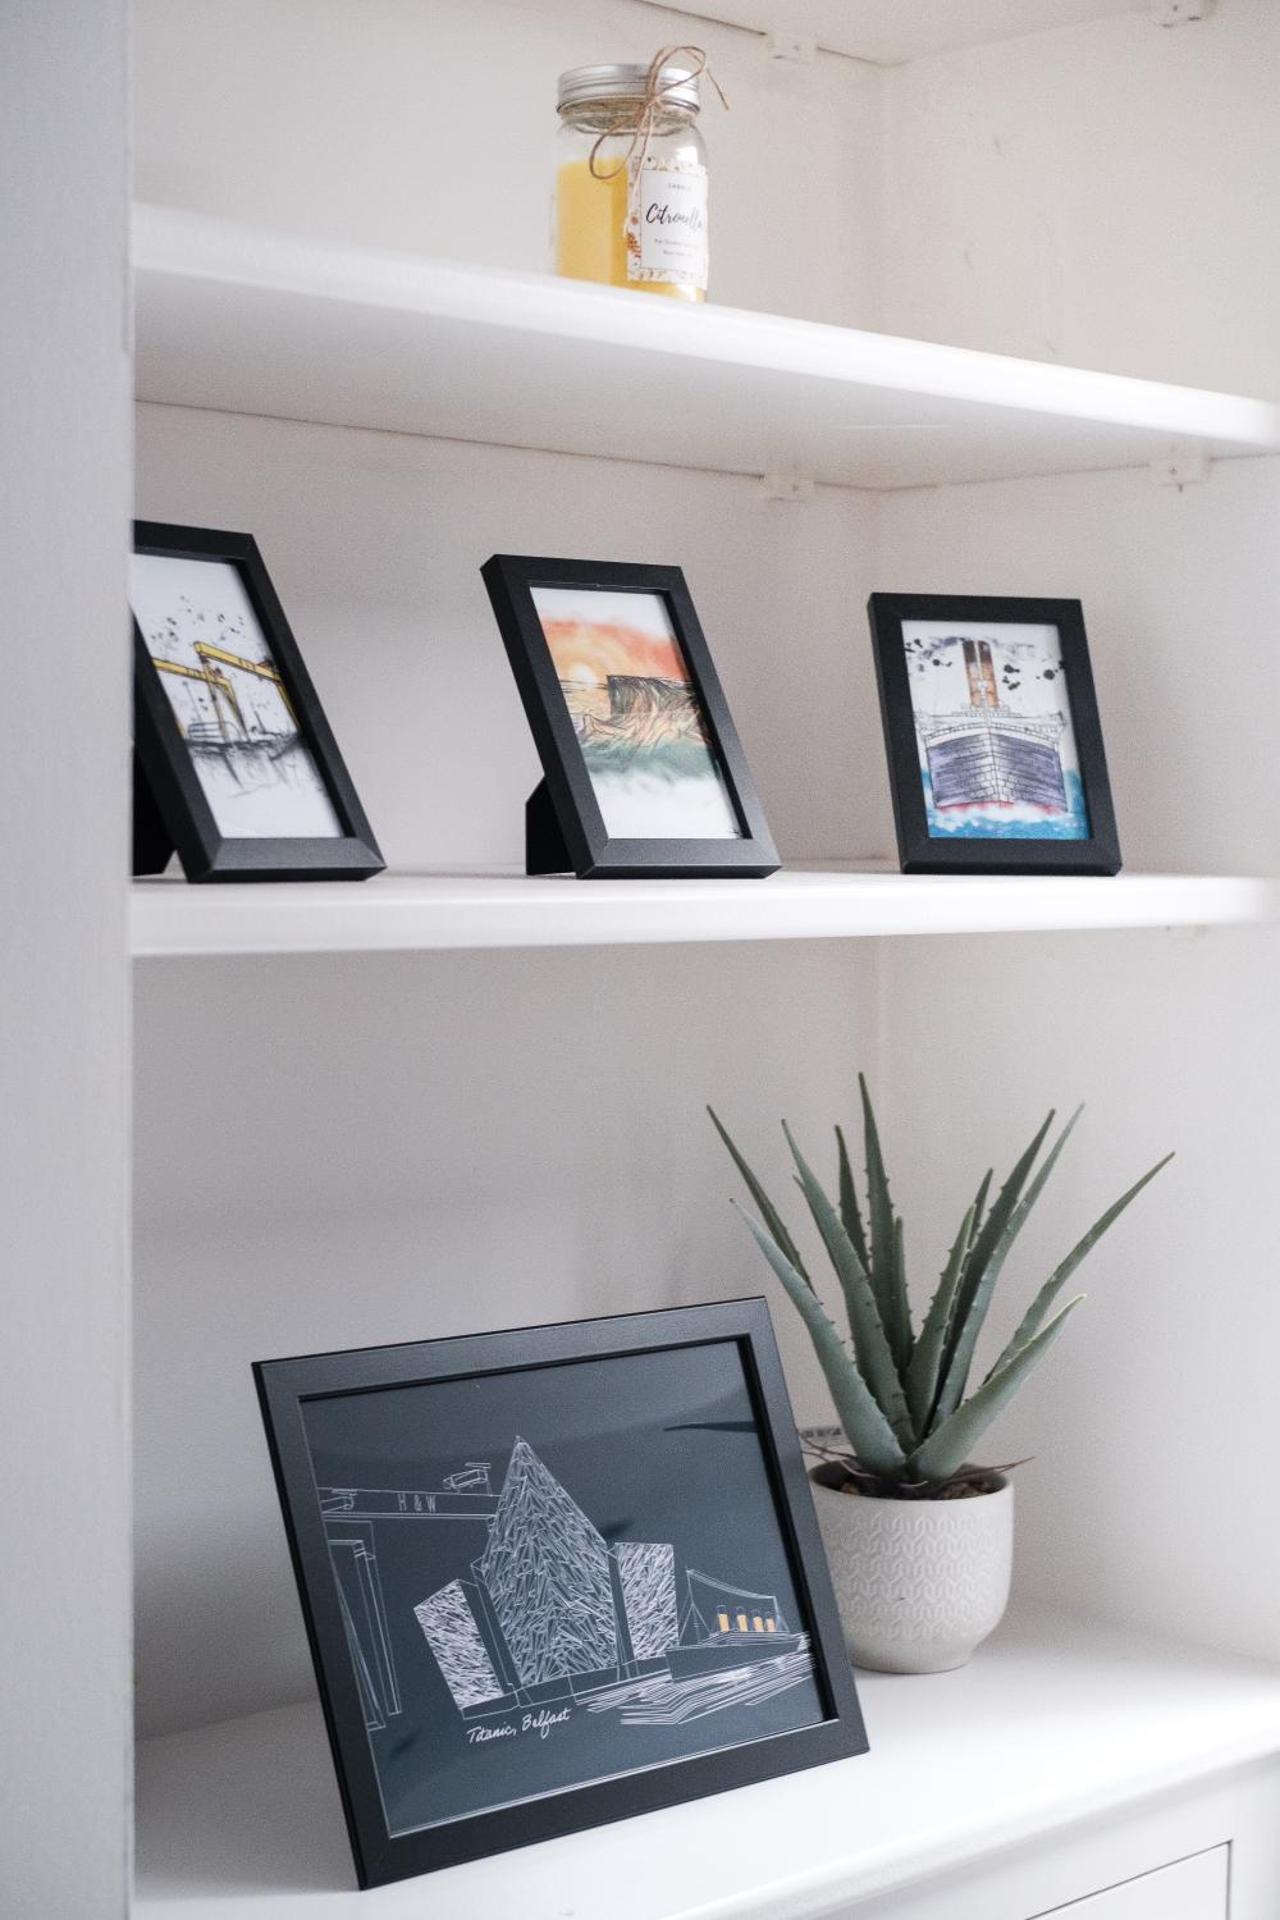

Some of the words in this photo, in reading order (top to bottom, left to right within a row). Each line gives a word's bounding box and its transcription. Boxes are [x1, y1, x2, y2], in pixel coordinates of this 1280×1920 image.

[397, 1493, 407, 1511] H
[426, 1494, 437, 1512] W
[466, 1721, 517, 1744] Titanic,
[521, 1707, 572, 1739] Belfast
